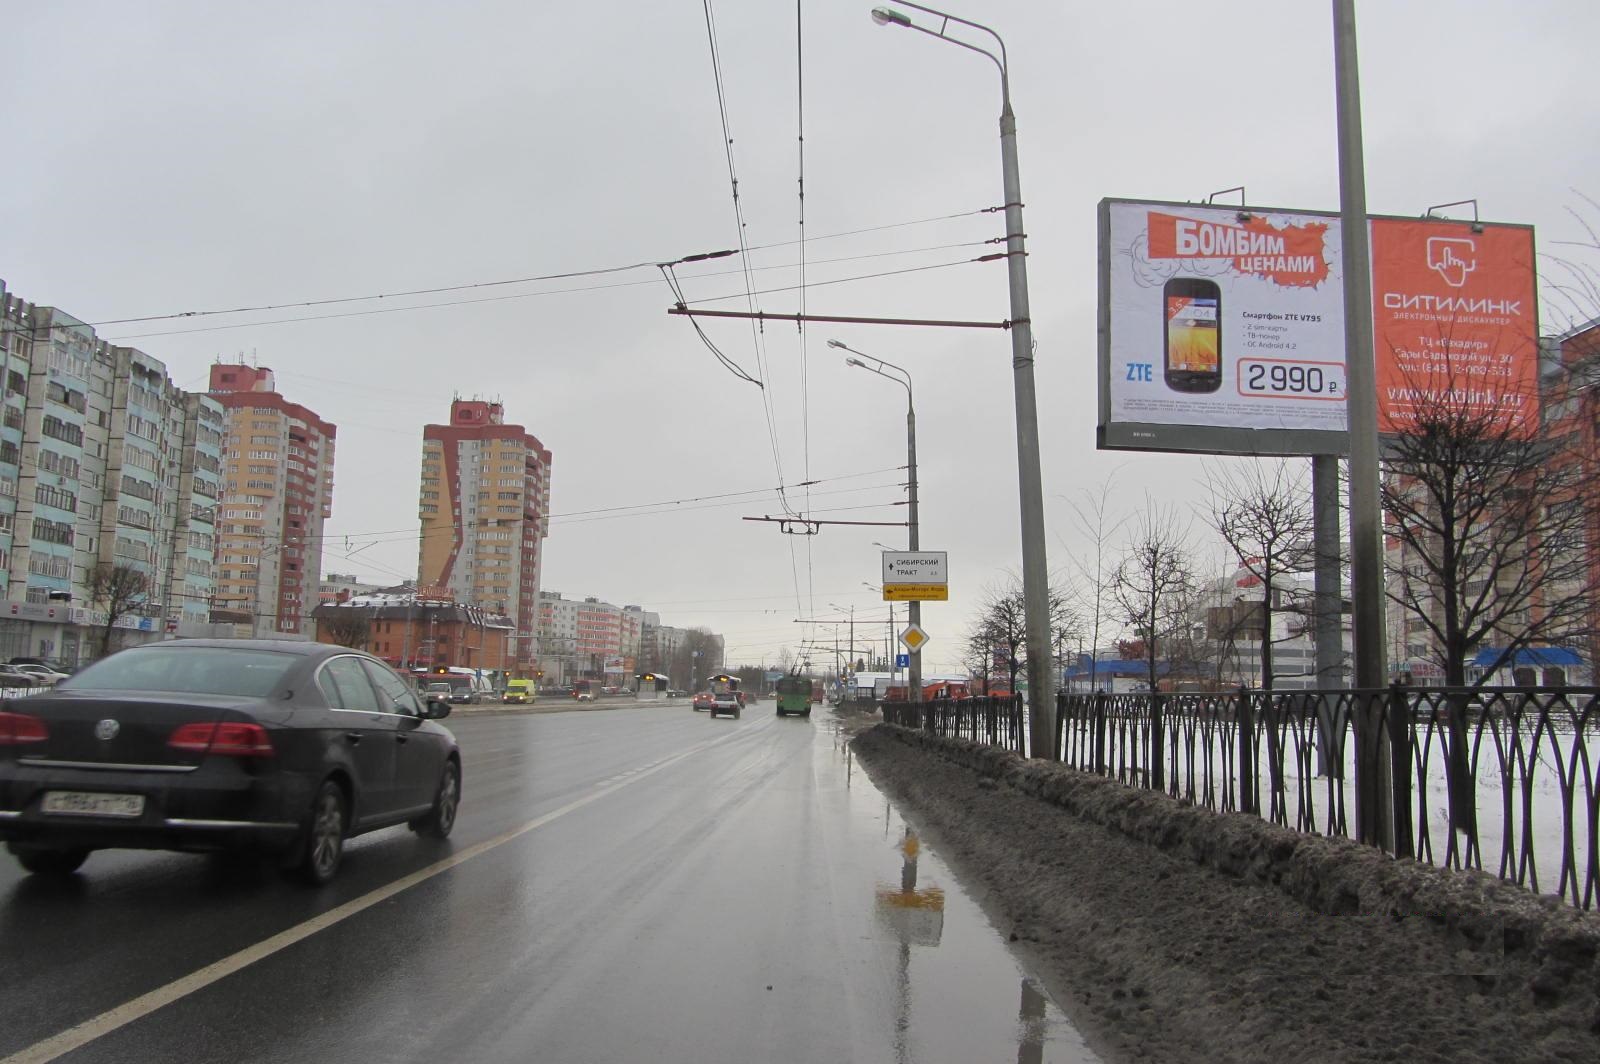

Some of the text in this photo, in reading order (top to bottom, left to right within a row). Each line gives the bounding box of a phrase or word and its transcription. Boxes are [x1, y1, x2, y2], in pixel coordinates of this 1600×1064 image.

[1175, 219, 1285, 256] БОМБИМ
[1240, 255, 1315, 273] ЦЕНАМИ
[1383, 293, 1521, 316] СИТИЛИНК
[1242, 311, 1322, 323] Смартфон ZTE V795
[1126, 363, 1152, 382] ZTE
[896, 558, 939, 566] СИБИРСКИЙ
